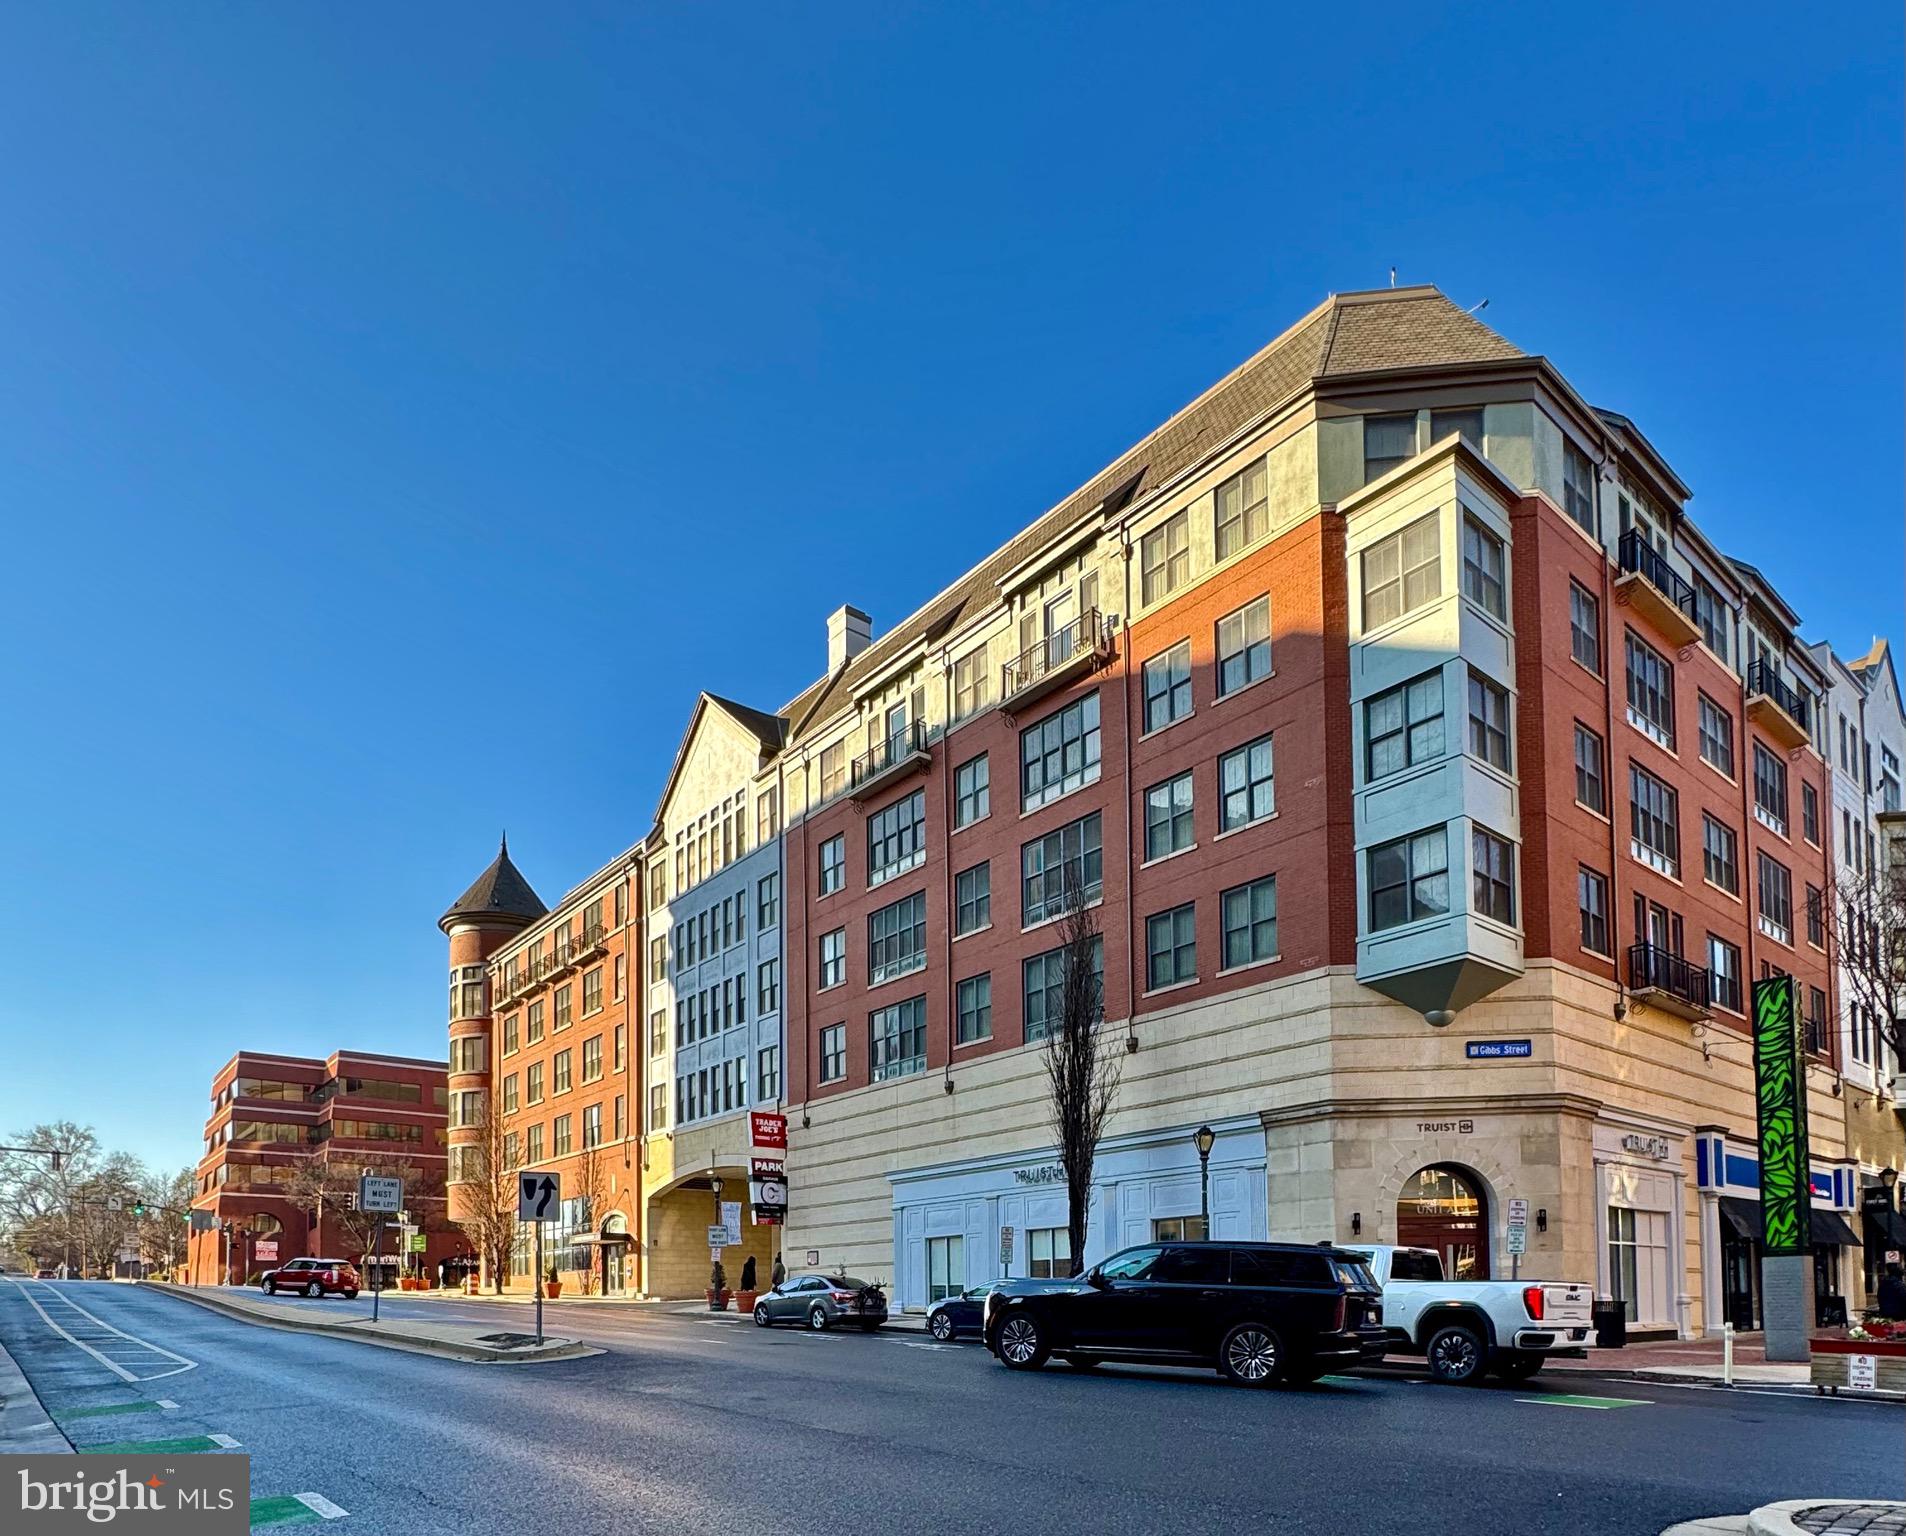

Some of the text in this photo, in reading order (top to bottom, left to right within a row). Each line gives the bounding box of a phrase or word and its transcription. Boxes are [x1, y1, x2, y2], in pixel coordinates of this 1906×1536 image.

[1480, 1044, 1528, 1055] Gibbs Street
[755, 1118, 782, 1127] TRADER
[1417, 1123, 1457, 1132] TRUIST
[755, 1161, 783, 1172] PARK
[1013, 1166, 1055, 1183] TRUIST
[372, 1190, 393, 1199] MUST
[761, 1182, 780, 1204] C
